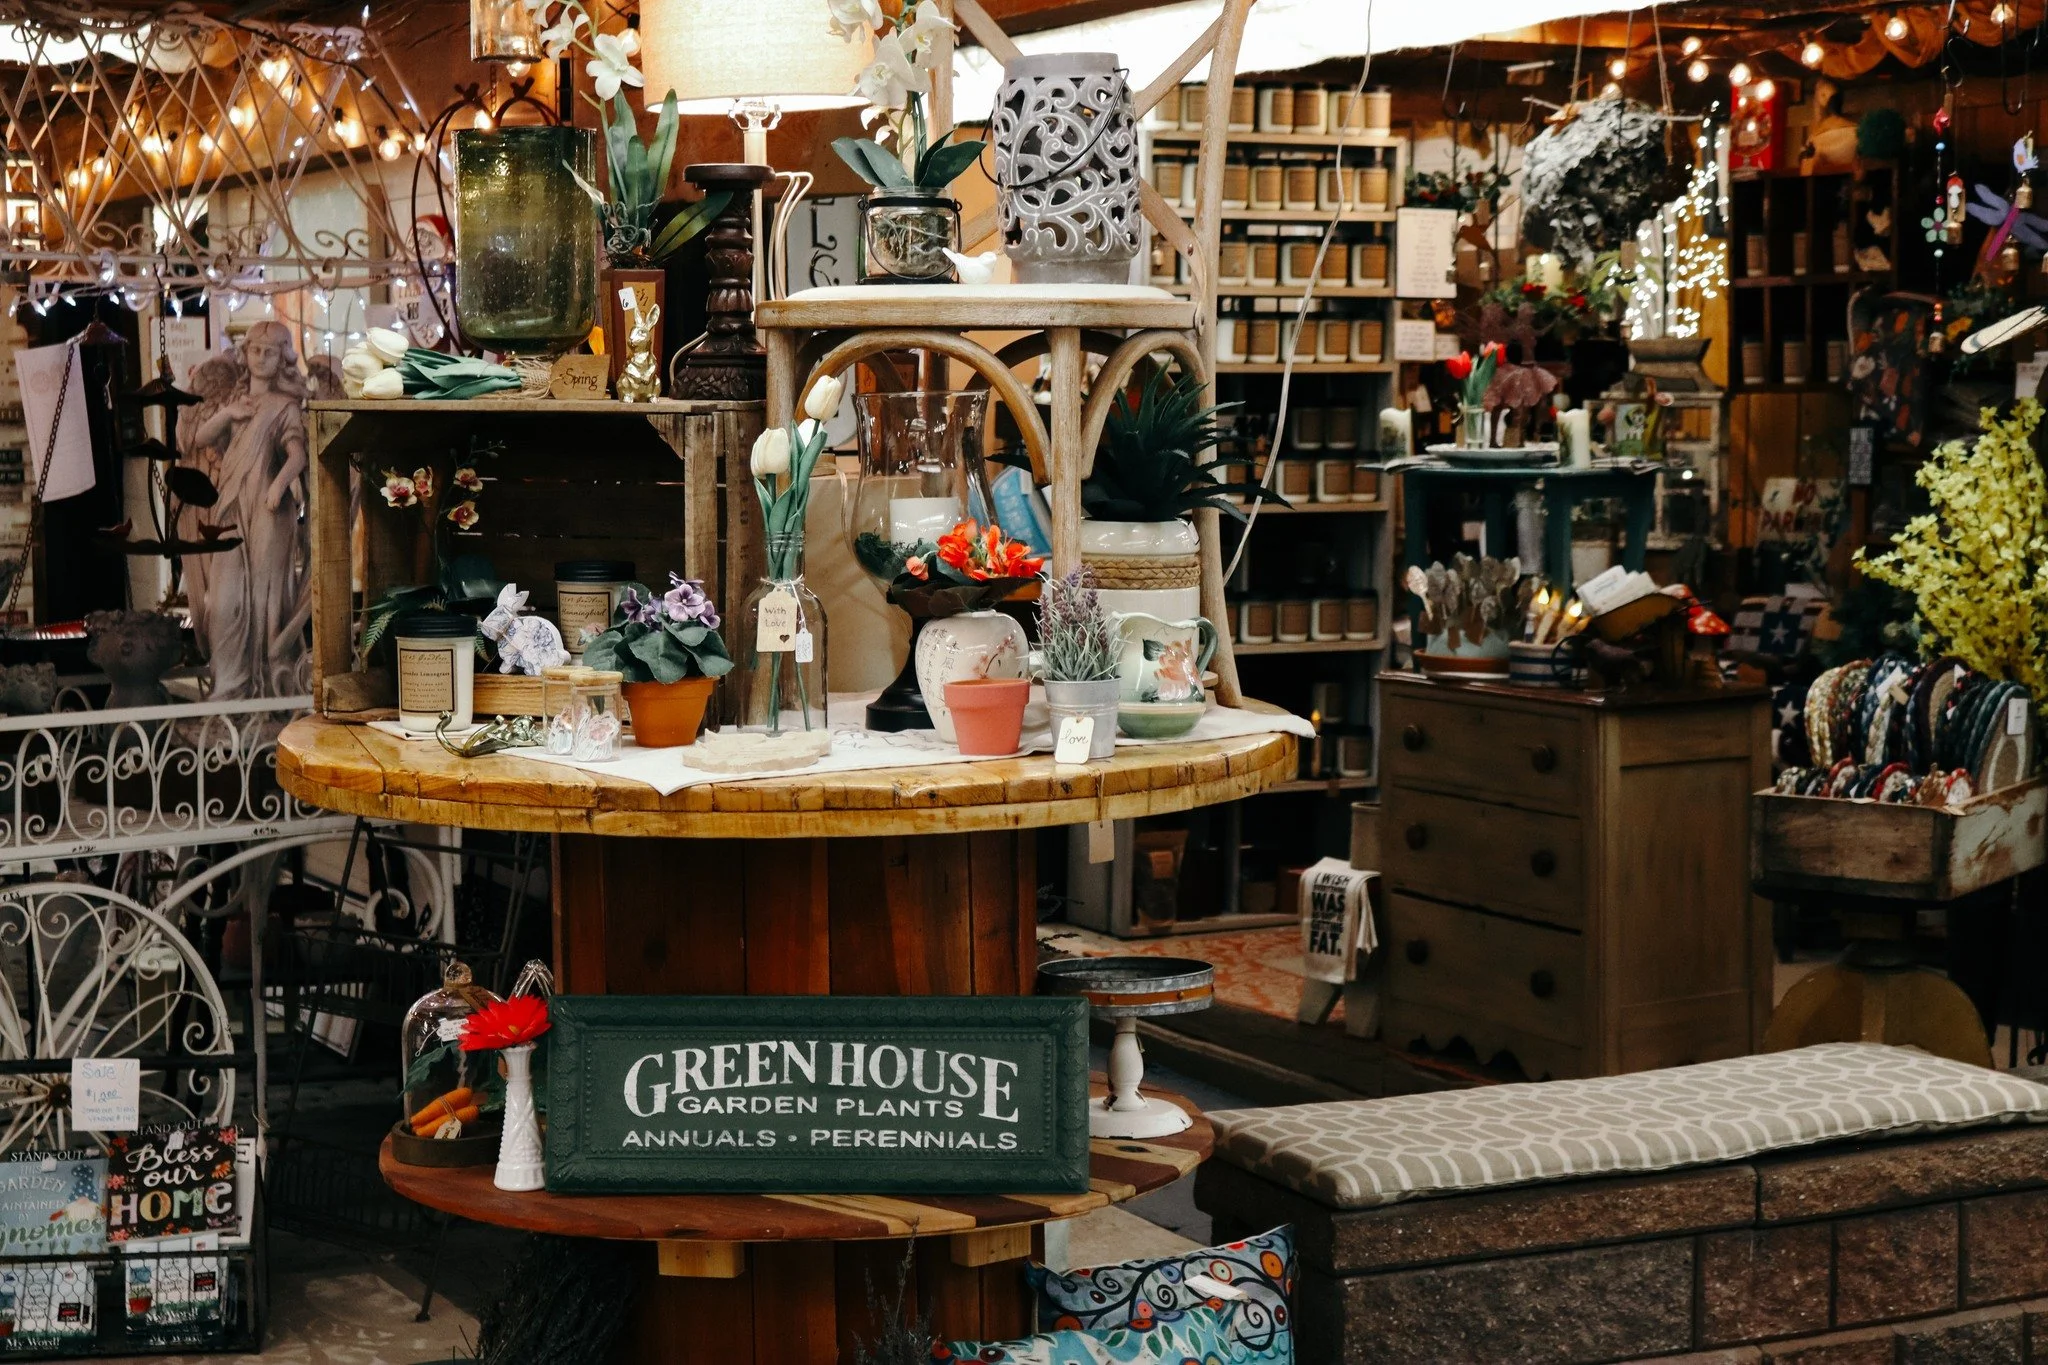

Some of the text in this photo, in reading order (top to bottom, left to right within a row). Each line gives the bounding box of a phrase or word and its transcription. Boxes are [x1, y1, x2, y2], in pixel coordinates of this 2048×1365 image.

[561, 367, 599, 391] Spring
[764, 606, 787, 616] With
[765, 619, 787, 628] Love
[1321, 873, 1352, 887] WISH
[1311, 891, 1346, 914] WAS
[1309, 931, 1342, 957] FAT.
[828, 1043, 1018, 1122] HOUSE
[678, 1096, 964, 1118] GARDEN PLANTS
[623, 1129, 1018, 1150] ANNUALS PERENNIALS
[125, 1143, 219, 1173] Bless
[143, 1163, 205, 1187] our
[0, 1199, 67, 1210] AINTAINED
[110, 1181, 232, 1226] HOME
